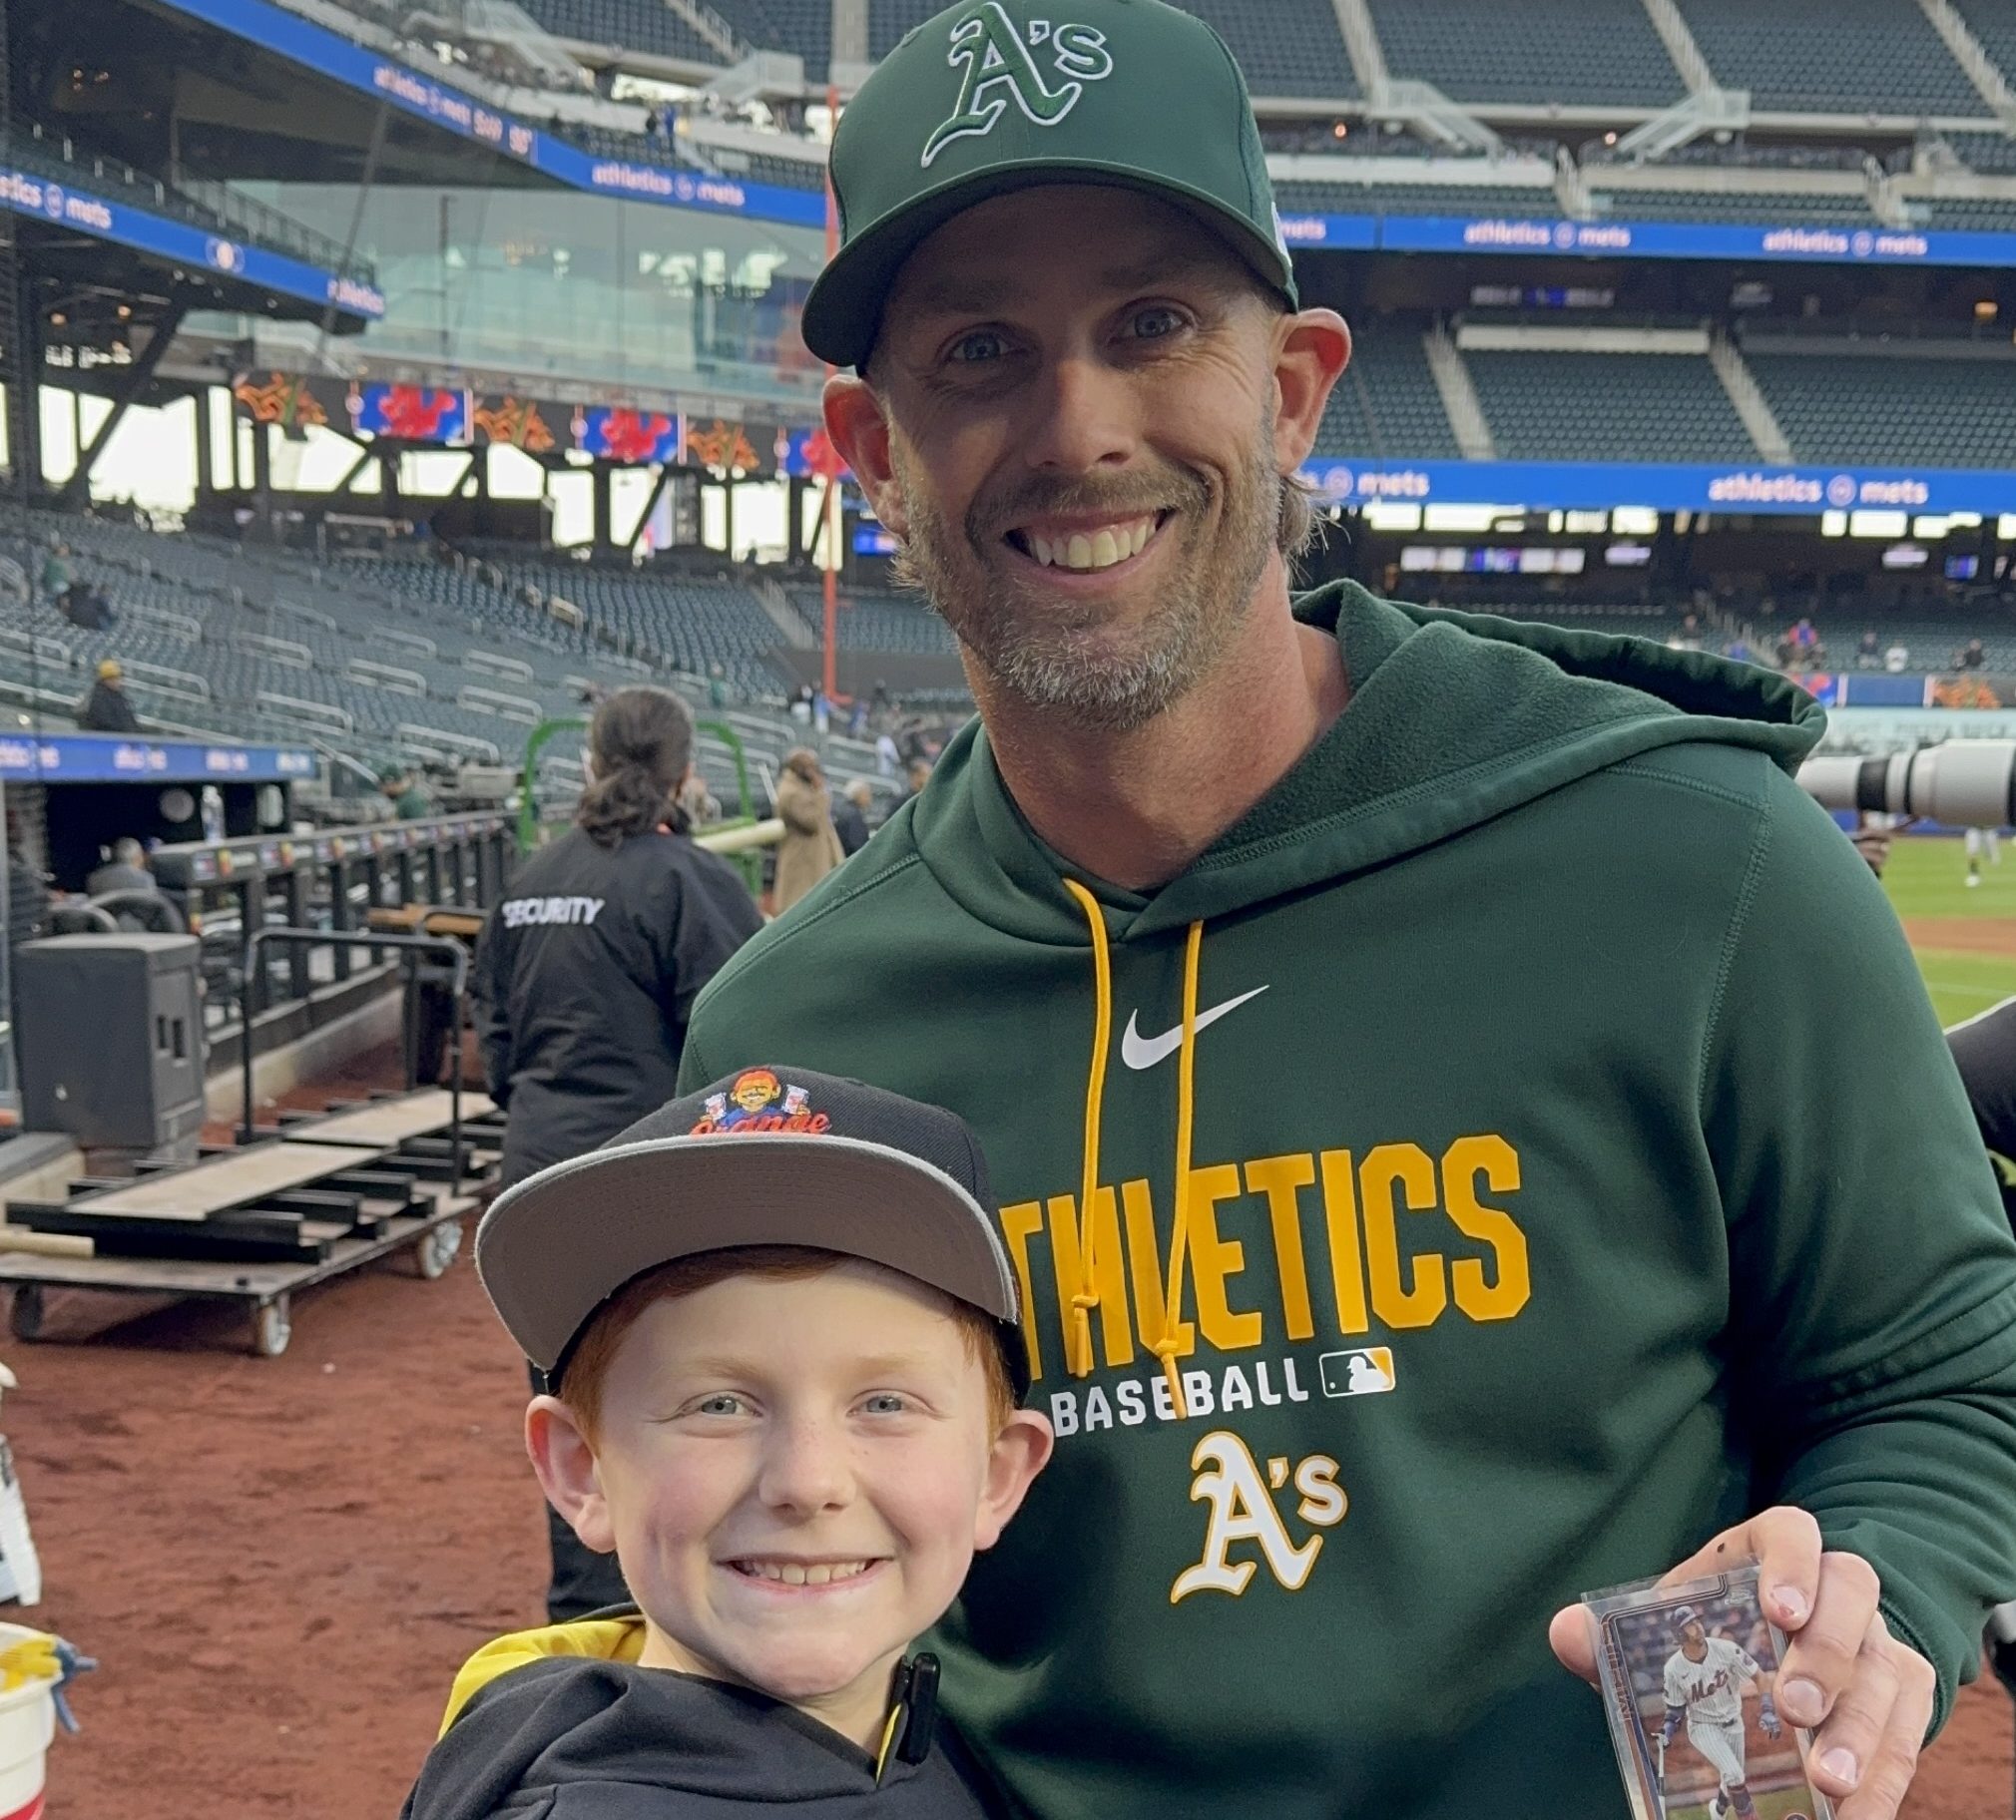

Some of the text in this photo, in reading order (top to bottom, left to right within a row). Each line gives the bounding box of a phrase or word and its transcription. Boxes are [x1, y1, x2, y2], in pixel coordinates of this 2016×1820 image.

[921, 2, 1113, 168] A's
[697, 182, 745, 207] mets
[1463, 219, 1551, 245] athletics
[1578, 226, 1631, 247] mets
[1763, 228, 1848, 253] athletics
[1875, 234, 1928, 255] mets
[1357, 469, 1430, 497] mets
[1709, 472, 1823, 503] athletics
[1859, 478, 1929, 505] mets
[501, 896, 606, 929] SECURITY
[998, 1134, 1531, 1382] THLETICS
[1050, 1357, 1308, 1438] BASEBALL
[1170, 1430, 1348, 1603] A's
